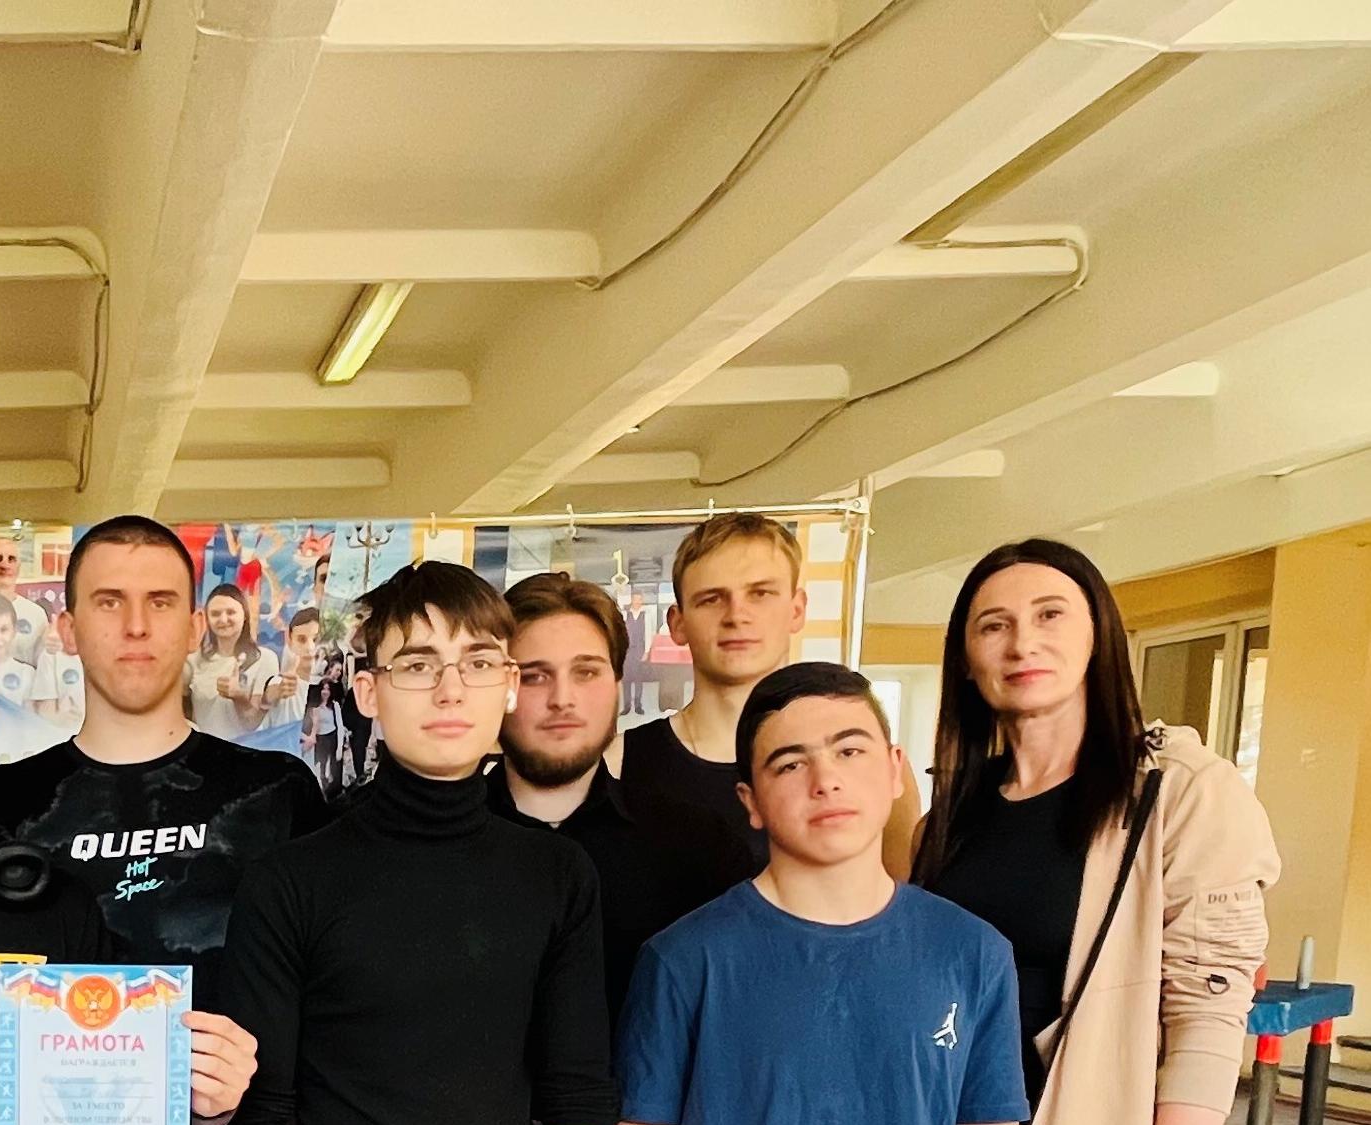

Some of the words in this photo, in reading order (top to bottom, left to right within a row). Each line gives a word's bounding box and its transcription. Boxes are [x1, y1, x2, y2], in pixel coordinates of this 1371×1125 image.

[70, 823, 207, 862] QUEEN
[125, 856, 158, 878] Hot
[114, 878, 164, 901] Space
[1207, 893, 1228, 905] DO
[40, 1034, 145, 1052] ГРАМОТА
